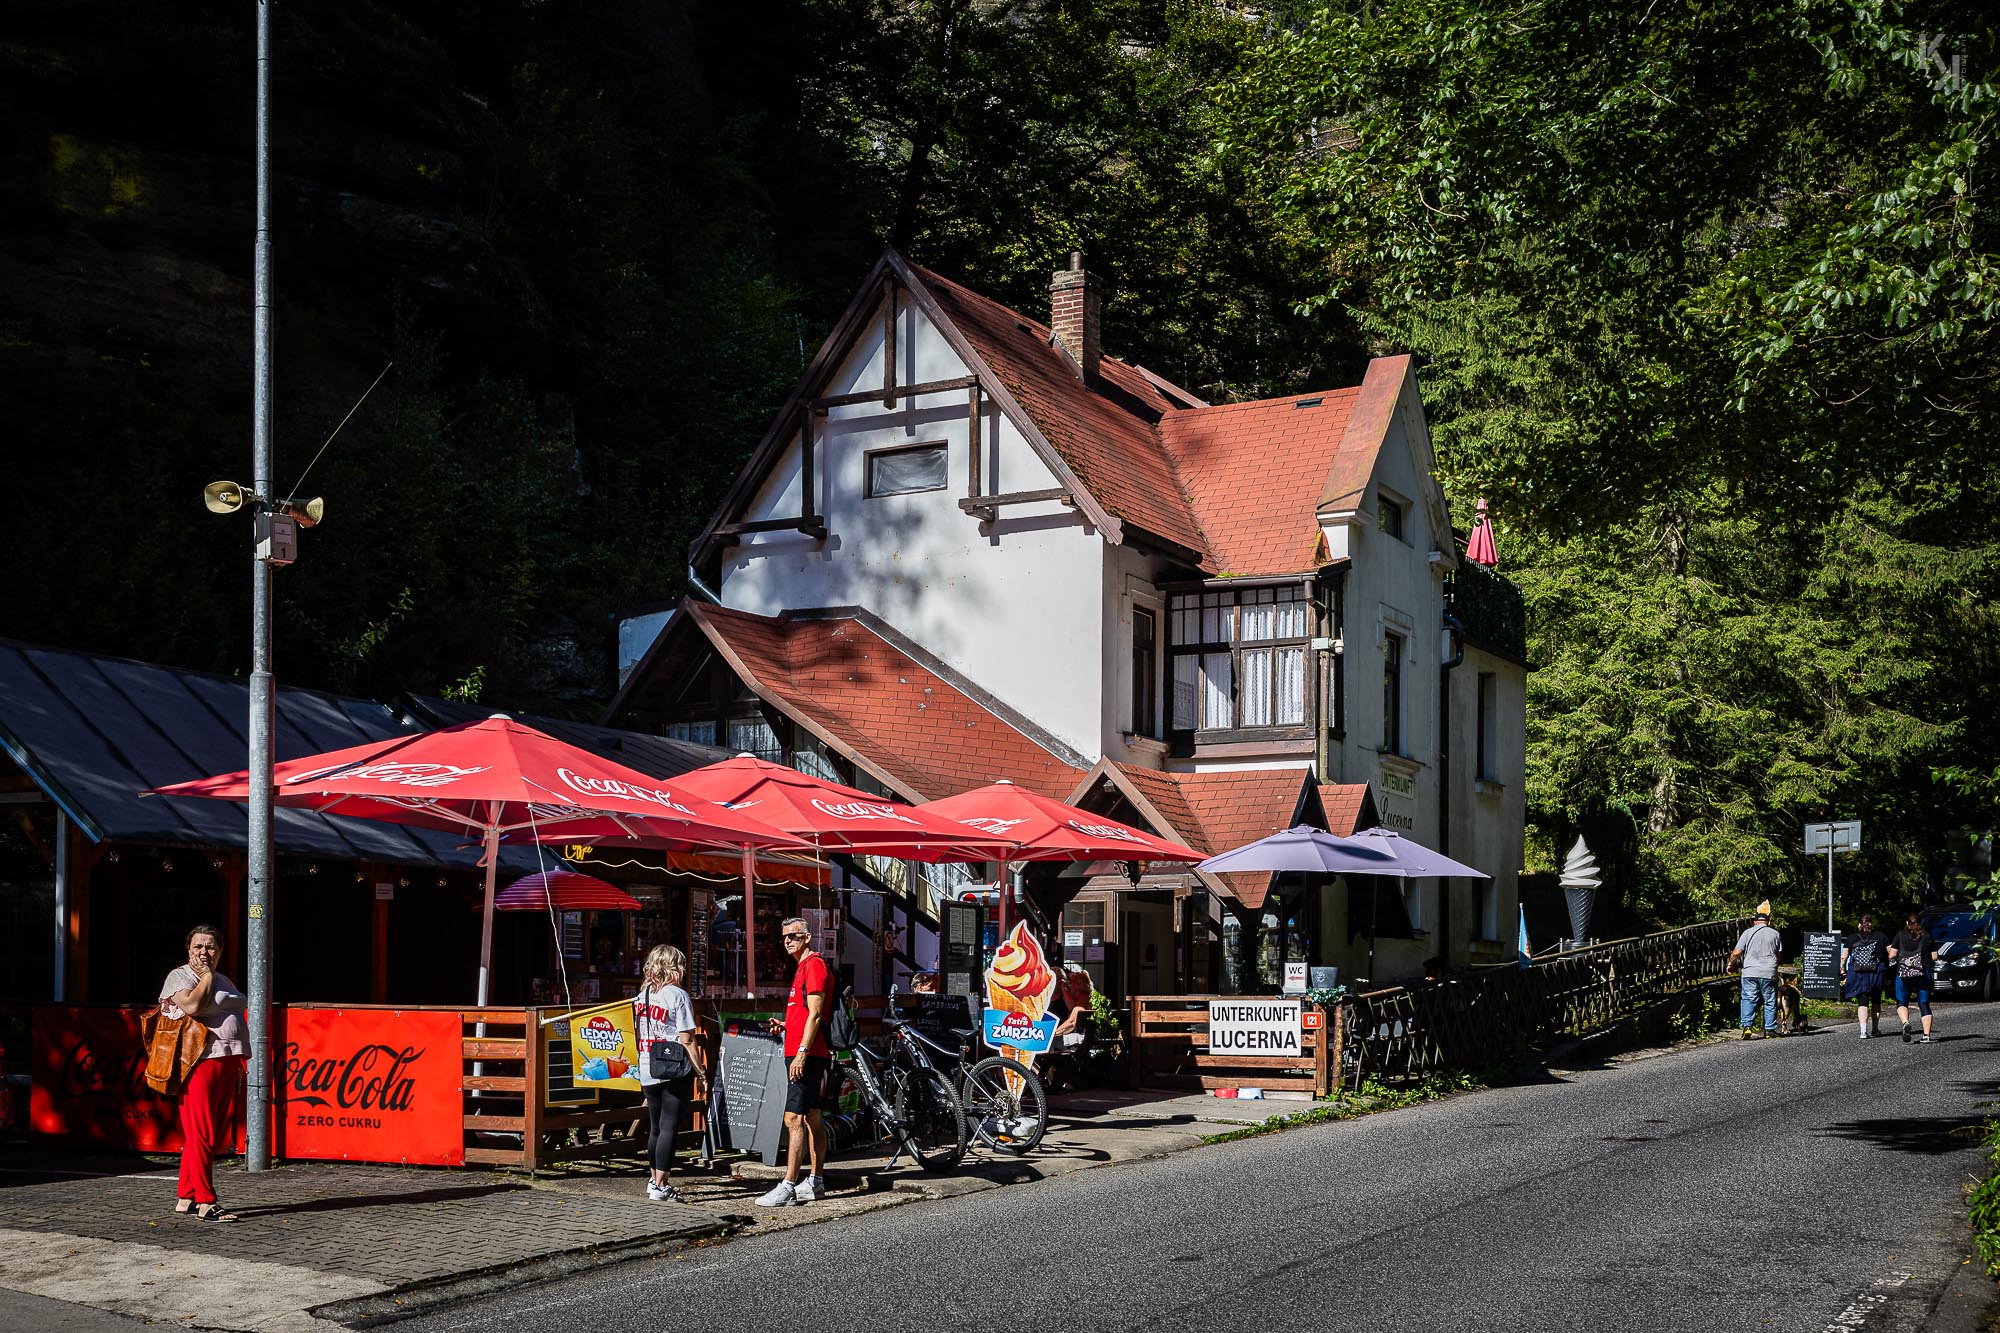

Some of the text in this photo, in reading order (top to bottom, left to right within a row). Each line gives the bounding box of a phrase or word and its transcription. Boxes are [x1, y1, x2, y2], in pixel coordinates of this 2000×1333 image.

[1381, 769, 1413, 797] UNTERKUNFT
[1379, 795, 1413, 831] Lucerna
[1288, 966, 1303, 975] WC
[1007, 1017, 1028, 1026] Tatra
[1212, 1006, 1298, 1022] UNTERKUNFT
[1306, 1016, 1318, 1026] 121
[591, 1020, 611, 1029] Tatra
[580, 1027, 624, 1043] LEDOVÁ
[992, 1025, 1046, 1041] ZMRZKA
[1212, 1030, 1298, 1049] LUCERNA
[272, 1042, 426, 1112] Coca-Cola
[297, 1115, 381, 1129] ZERO CUKRU
